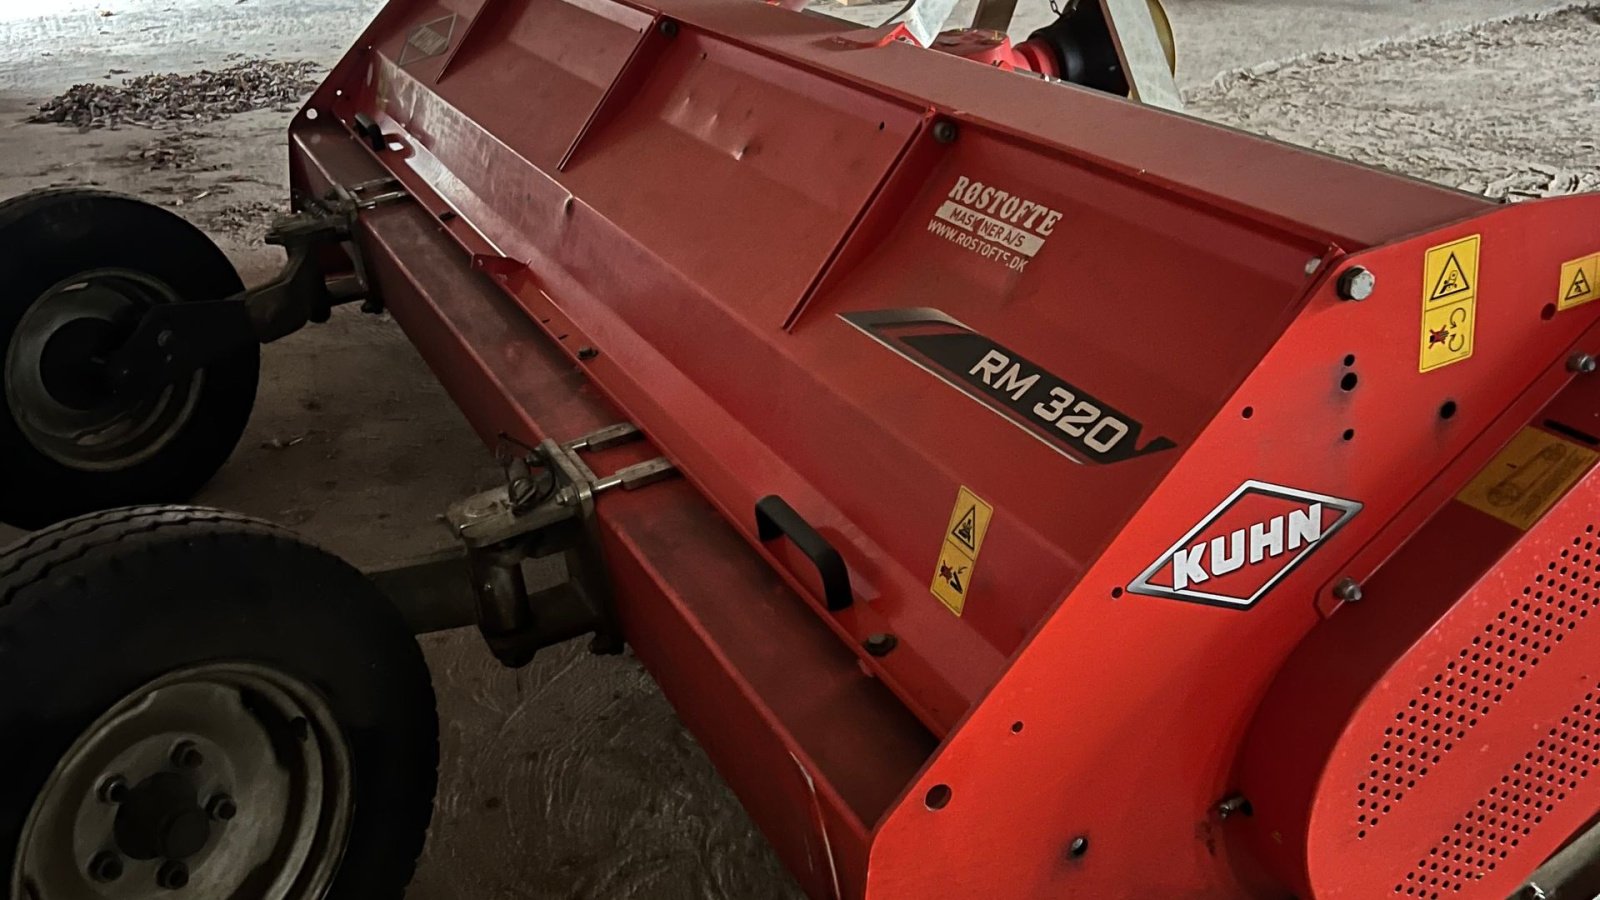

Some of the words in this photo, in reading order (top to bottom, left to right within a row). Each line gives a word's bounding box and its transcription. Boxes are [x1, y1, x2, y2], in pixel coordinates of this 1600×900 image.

[949, 175, 1063, 236] RØSTOFTE
[1003, 231, 1026, 248] A/S
[969, 349, 1041, 401] RM
[1033, 386, 1129, 453] 320
[1173, 502, 1322, 591] KUHN
